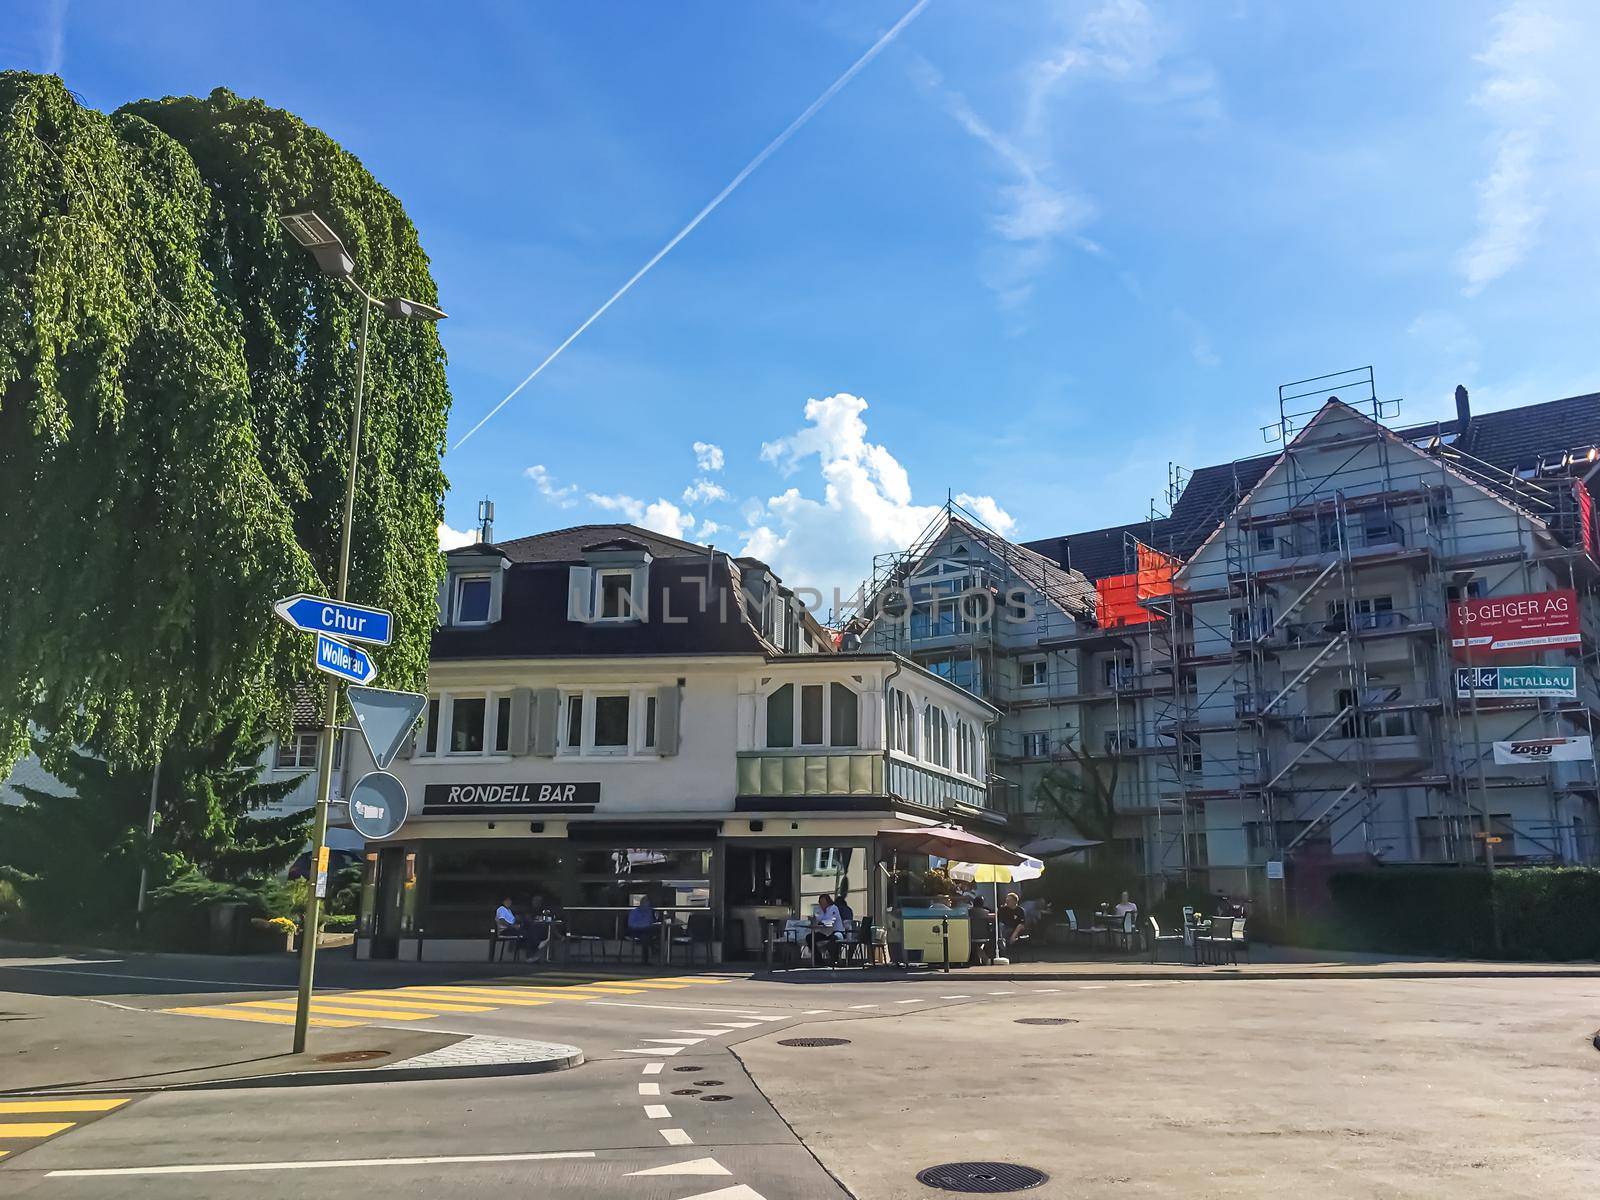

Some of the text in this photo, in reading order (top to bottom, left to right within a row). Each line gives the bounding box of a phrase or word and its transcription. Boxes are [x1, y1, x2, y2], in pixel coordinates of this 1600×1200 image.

[321, 606, 366, 632] Chur
[1479, 600, 1539, 619] GEIGER
[1544, 597, 1568, 613] AG
[322, 640, 364, 675] Wollerau
[1510, 742, 1553, 756] Zogg
[448, 784, 576, 803] RONDELL BAR
